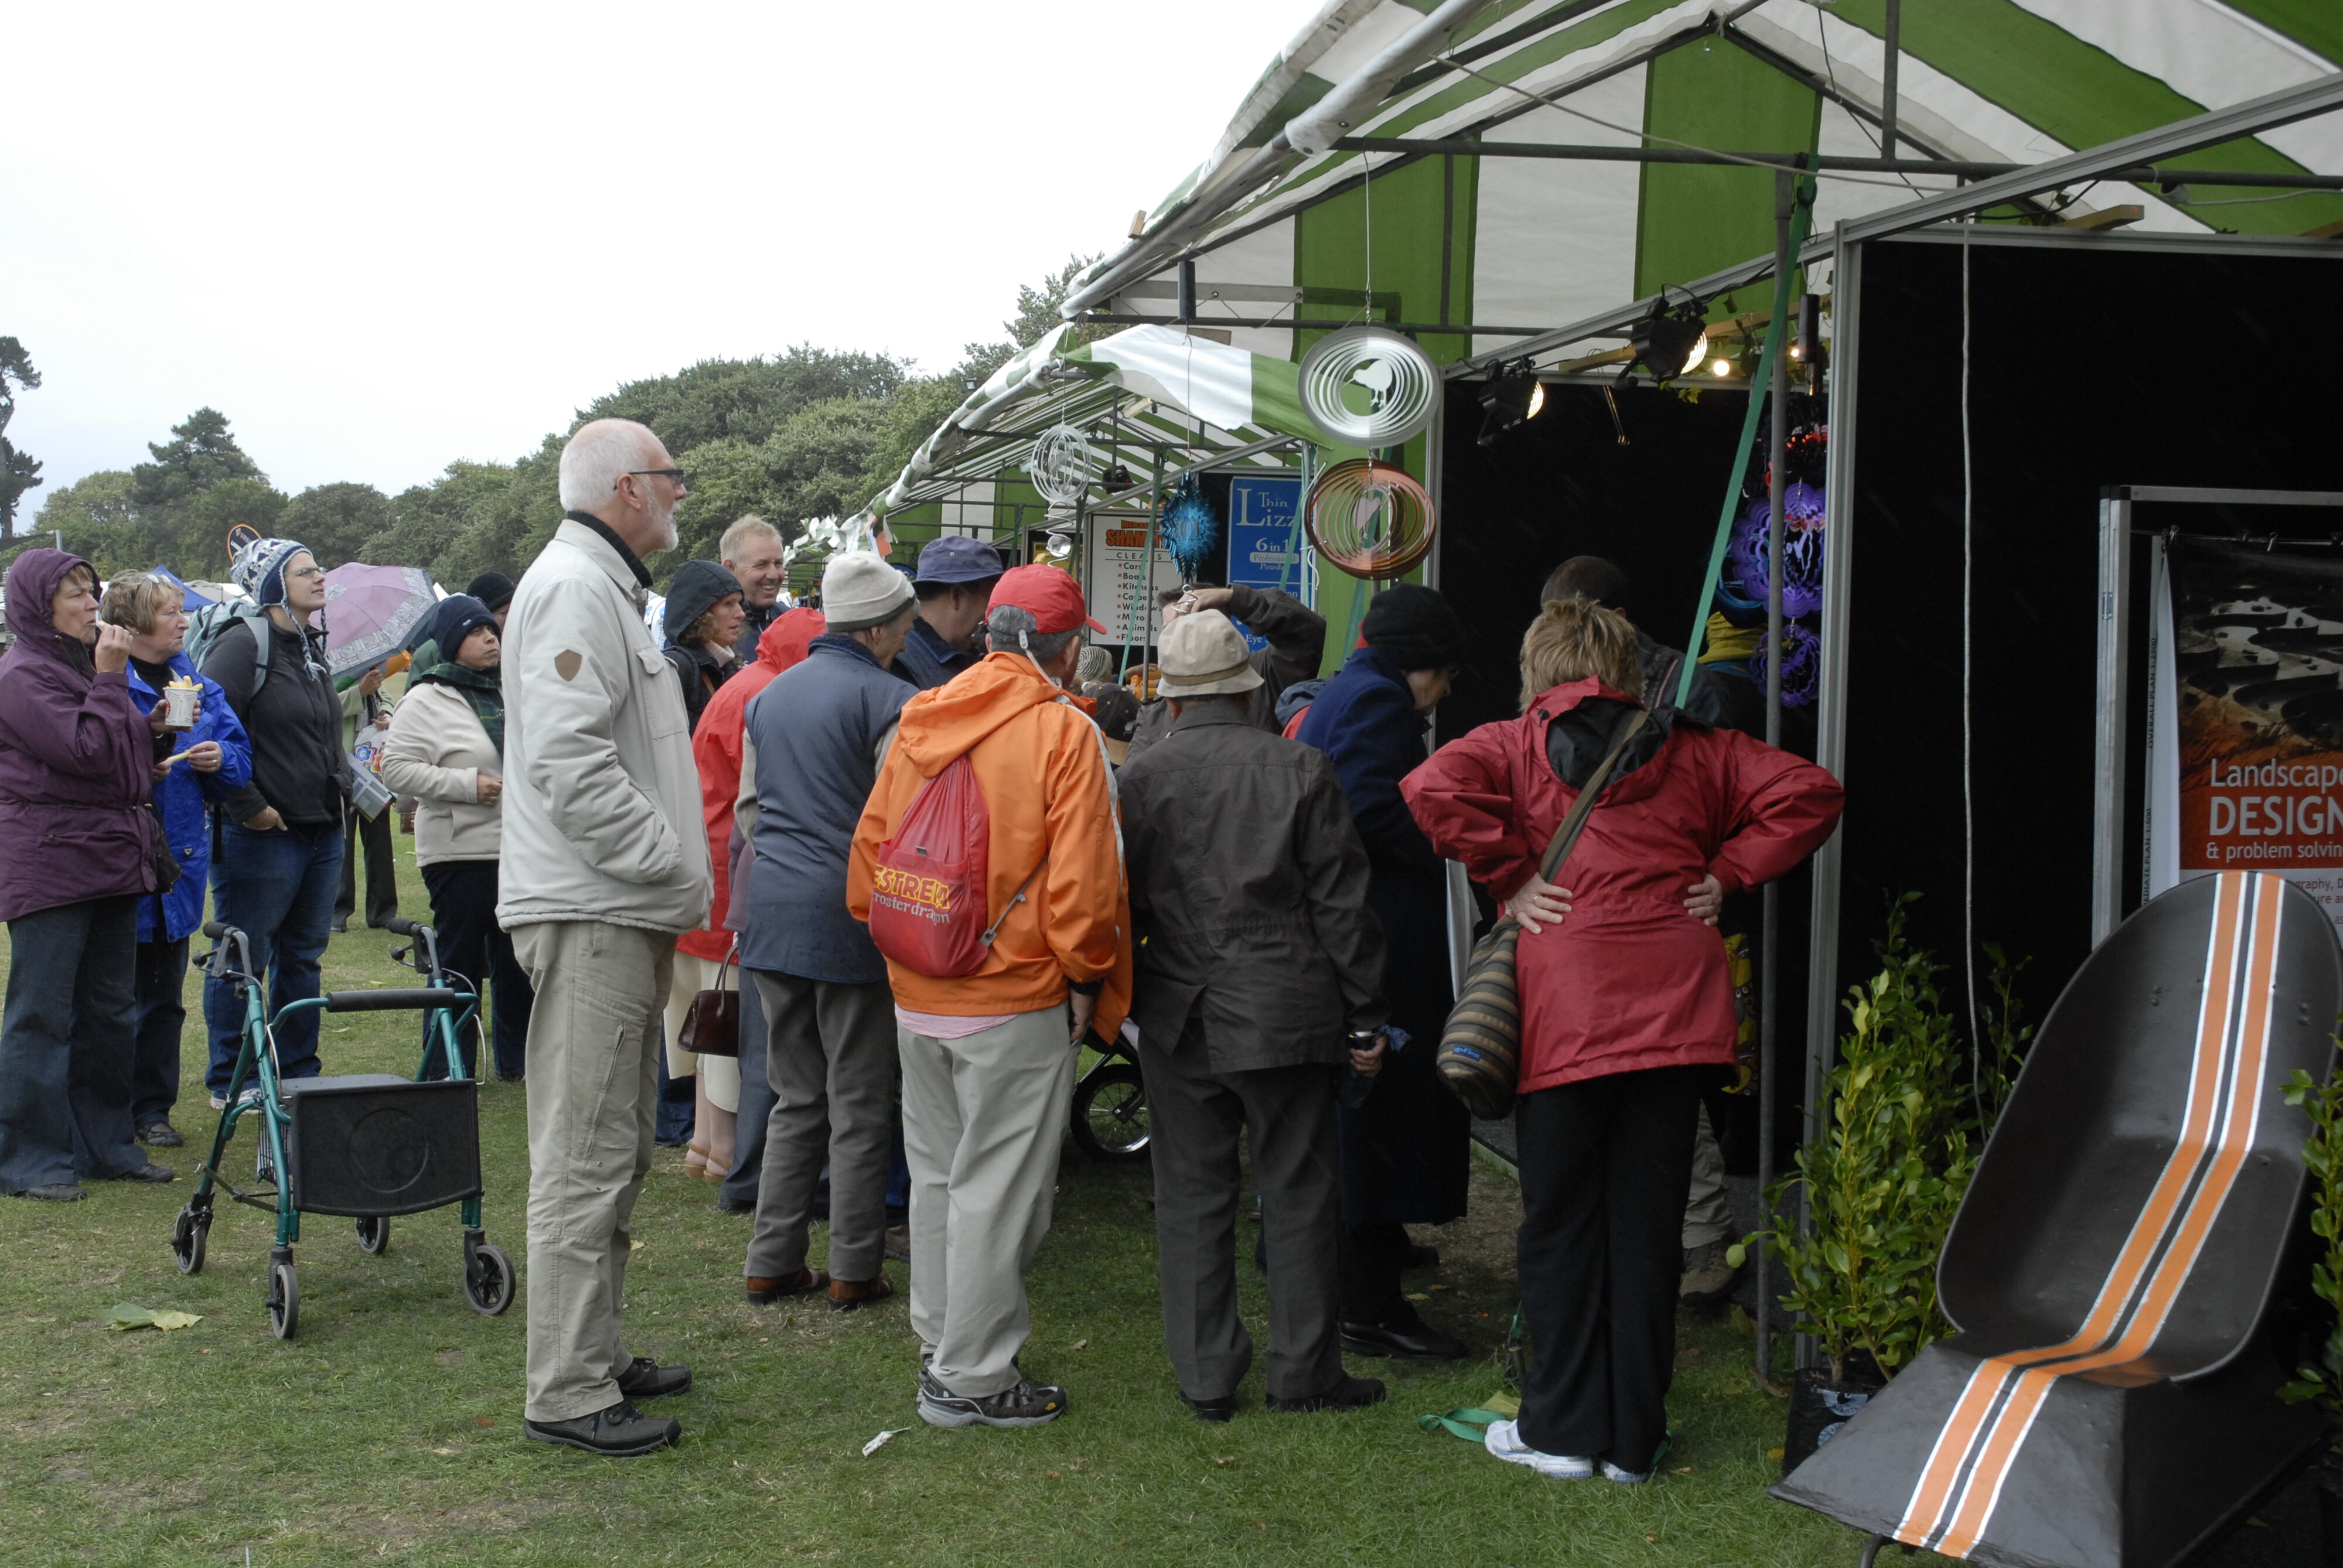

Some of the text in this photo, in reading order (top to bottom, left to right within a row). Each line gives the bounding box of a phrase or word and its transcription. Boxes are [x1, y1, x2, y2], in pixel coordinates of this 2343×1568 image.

[1258, 492, 1287, 507] Thin
[1256, 538, 1289, 552] 6 in 1
[1246, 634, 1262, 644] Eye
[2211, 758, 2343, 794] Landscap
[2206, 841, 2343, 863] & problem solvin
